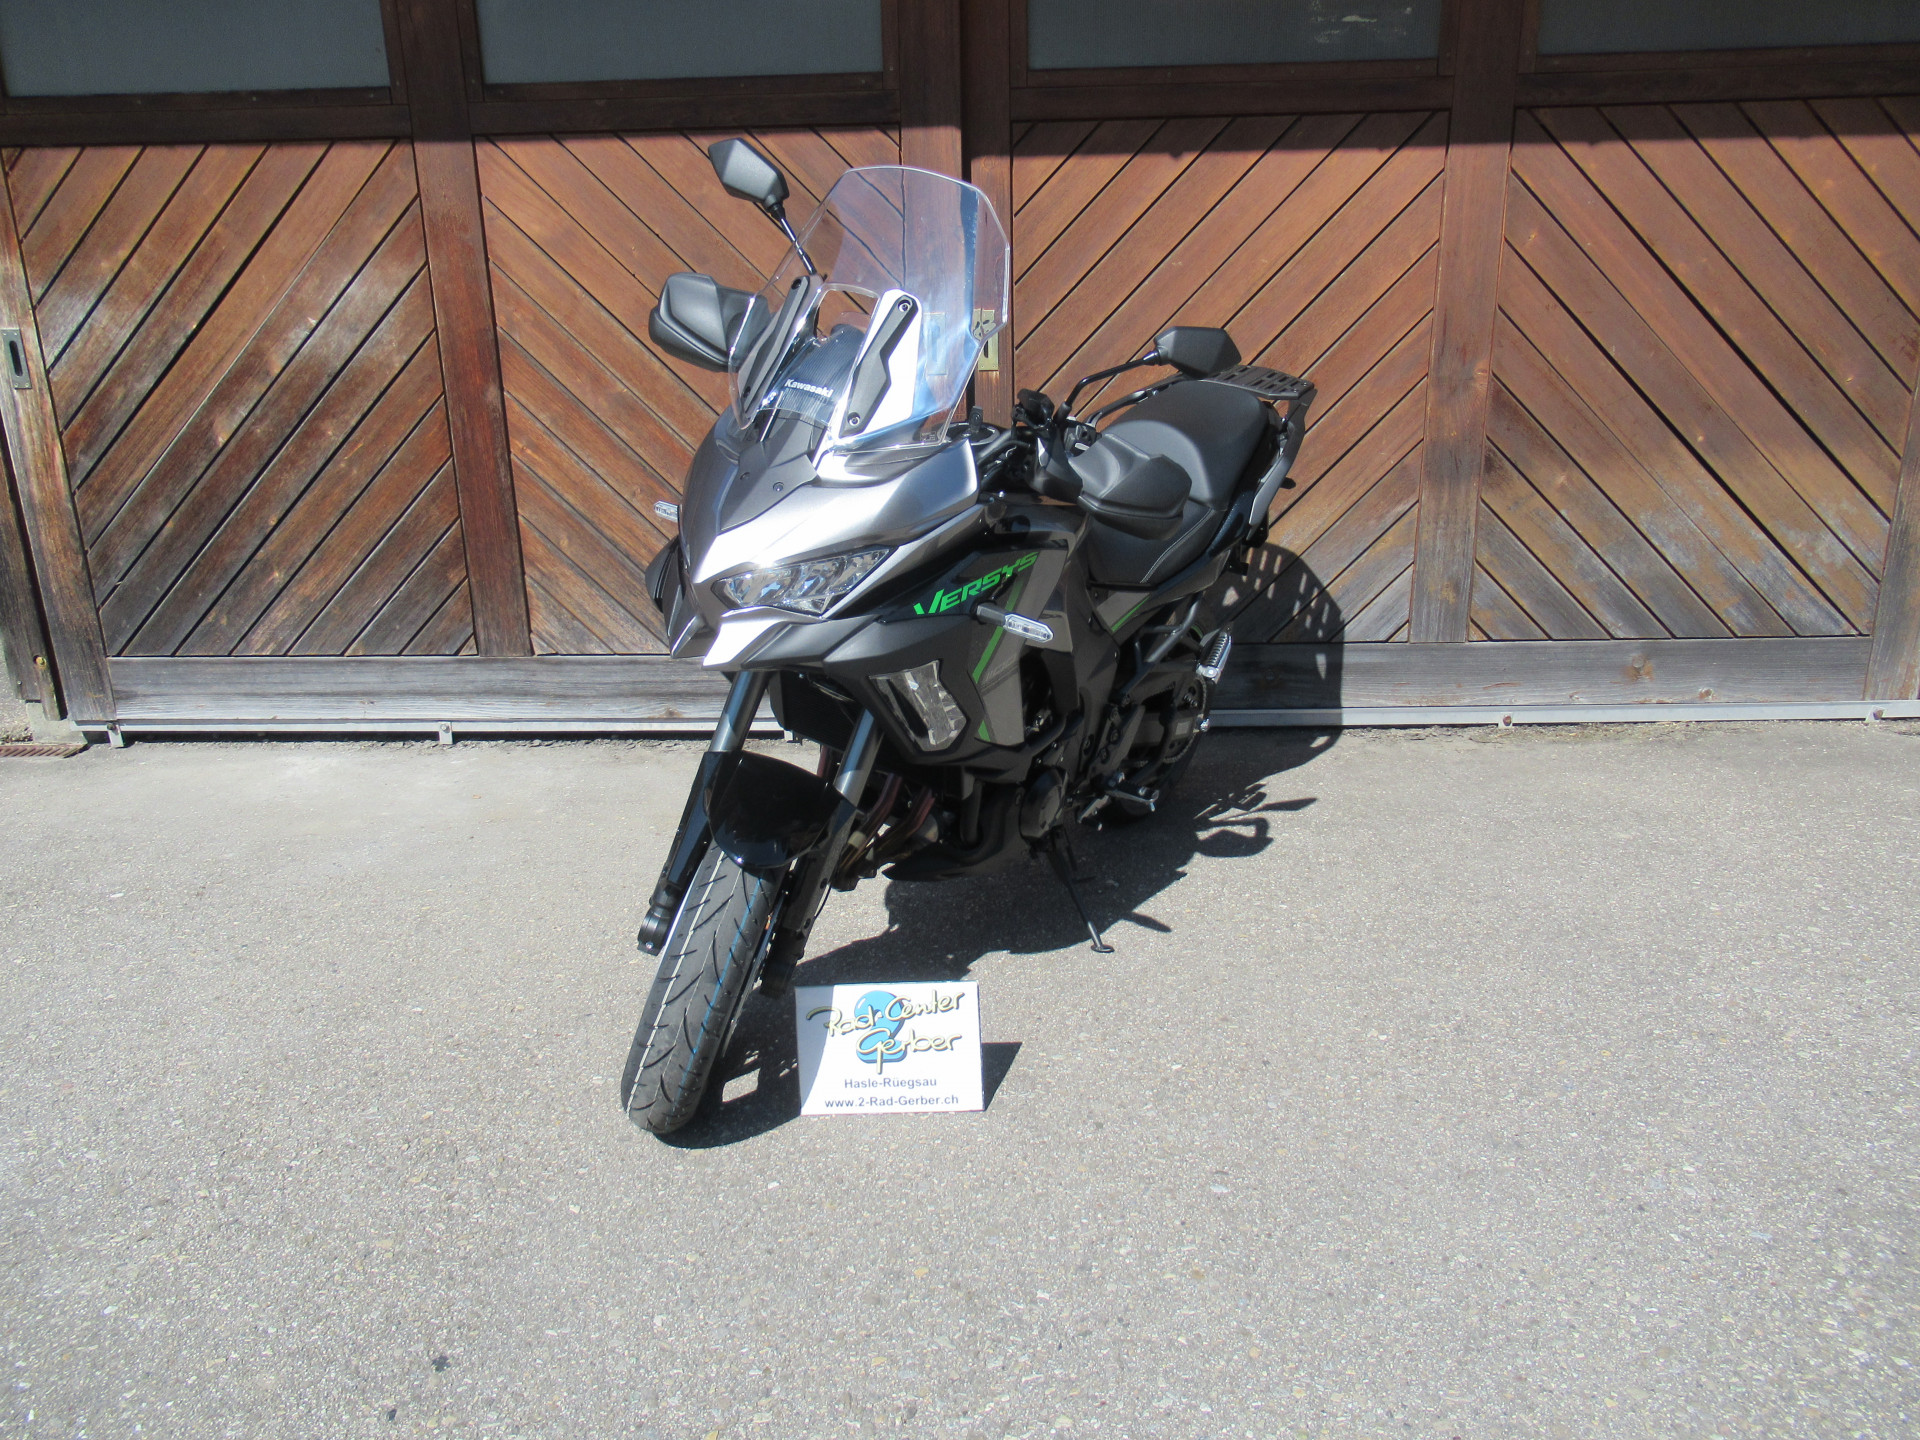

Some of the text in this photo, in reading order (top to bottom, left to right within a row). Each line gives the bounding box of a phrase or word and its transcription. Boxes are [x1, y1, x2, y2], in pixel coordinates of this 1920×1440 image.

[784, 378, 834, 398] Kawasaki
[913, 552, 1039, 615] VERSYS
[885, 990, 965, 1021] Center
[855, 1027, 962, 1075] Gerber
[844, 1077, 937, 1089] Hasle-Rüegsau
[825, 1094, 959, 1108] www.2-Rad-Gerber.ch
